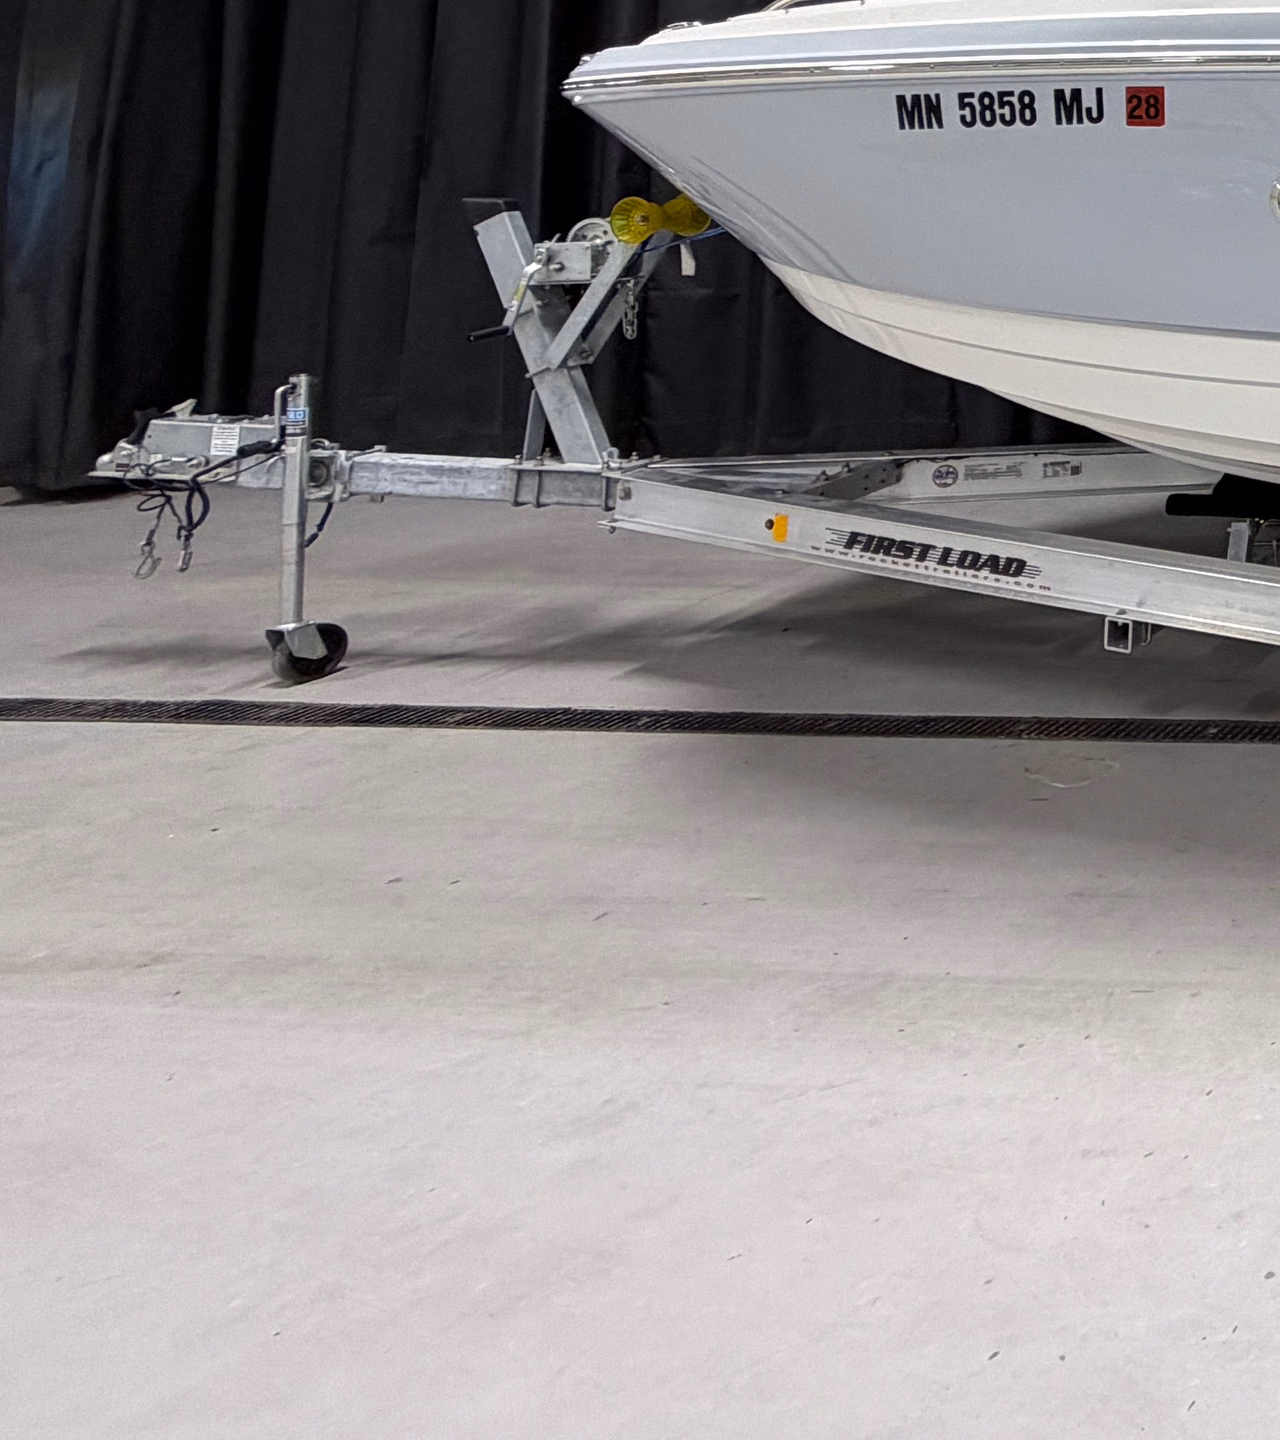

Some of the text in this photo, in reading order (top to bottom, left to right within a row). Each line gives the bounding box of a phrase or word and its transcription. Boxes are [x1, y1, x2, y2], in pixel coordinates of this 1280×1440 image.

[895, 86, 1105, 131] MN 5858 MJ
[1126, 93, 1161, 120] 28
[843, 531, 1028, 579] FIRST LOAD
